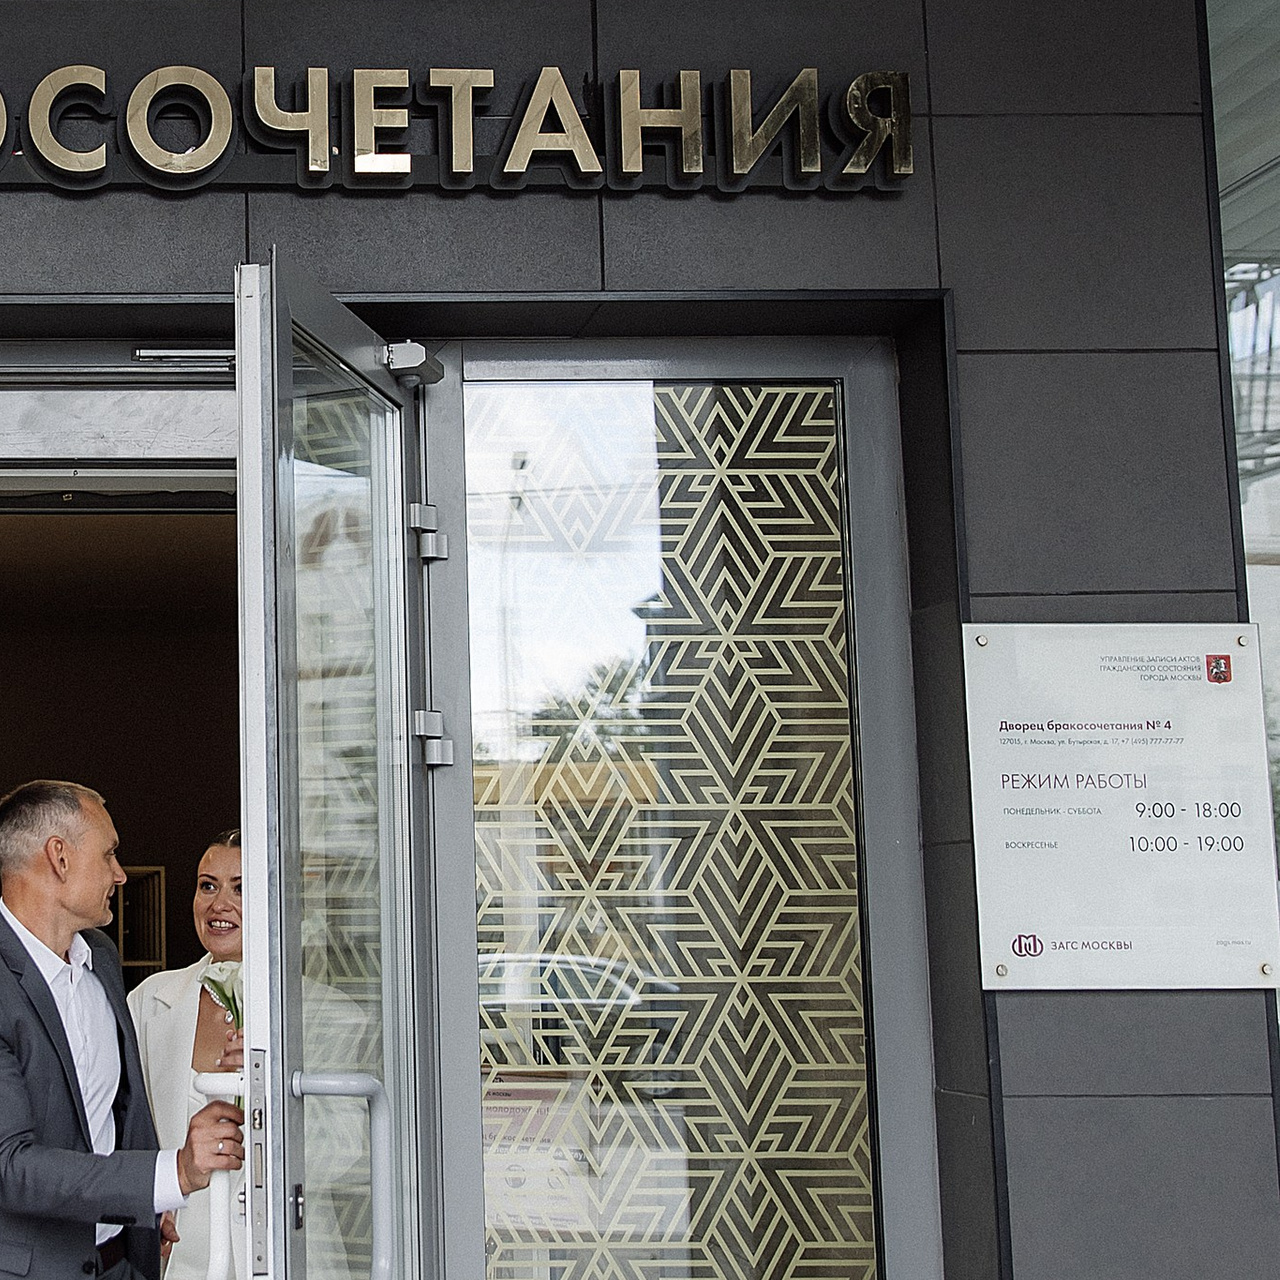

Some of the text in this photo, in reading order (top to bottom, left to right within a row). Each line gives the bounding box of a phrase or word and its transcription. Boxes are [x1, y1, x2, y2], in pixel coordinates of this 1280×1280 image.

[1100, 655, 1201, 663] УПРАВЛЕНИЕ ЗАПИСИ АКТОВ
[1099, 664, 1202, 673] ГРАЖДАНСКОГО СОСТОЯНИЯ
[1140, 674, 1202, 682] ГОРОДА МОСКВЫ
[999, 720, 1045, 734] Дворец
[1046, 719, 1143, 734] бракосочетания
[1163, 720, 1172, 730] 4
[1001, 773, 1148, 790] РЕЖИМ РАБОТЫ
[1003, 807, 1062, 816] ПОНЕДЕЛЬНИК
[1067, 807, 1103, 816] СУББОТА
[1135, 802, 1176, 818] 9:00
[1195, 802, 1242, 818] 18:00
[1005, 841, 1059, 850] ВОСКРЕСЕНЬЕ
[1129, 836, 1178, 852] 10:00
[1197, 835, 1245, 852] 19:00
[1051, 940, 1133, 950] ЗАГС МОСКВЫ
